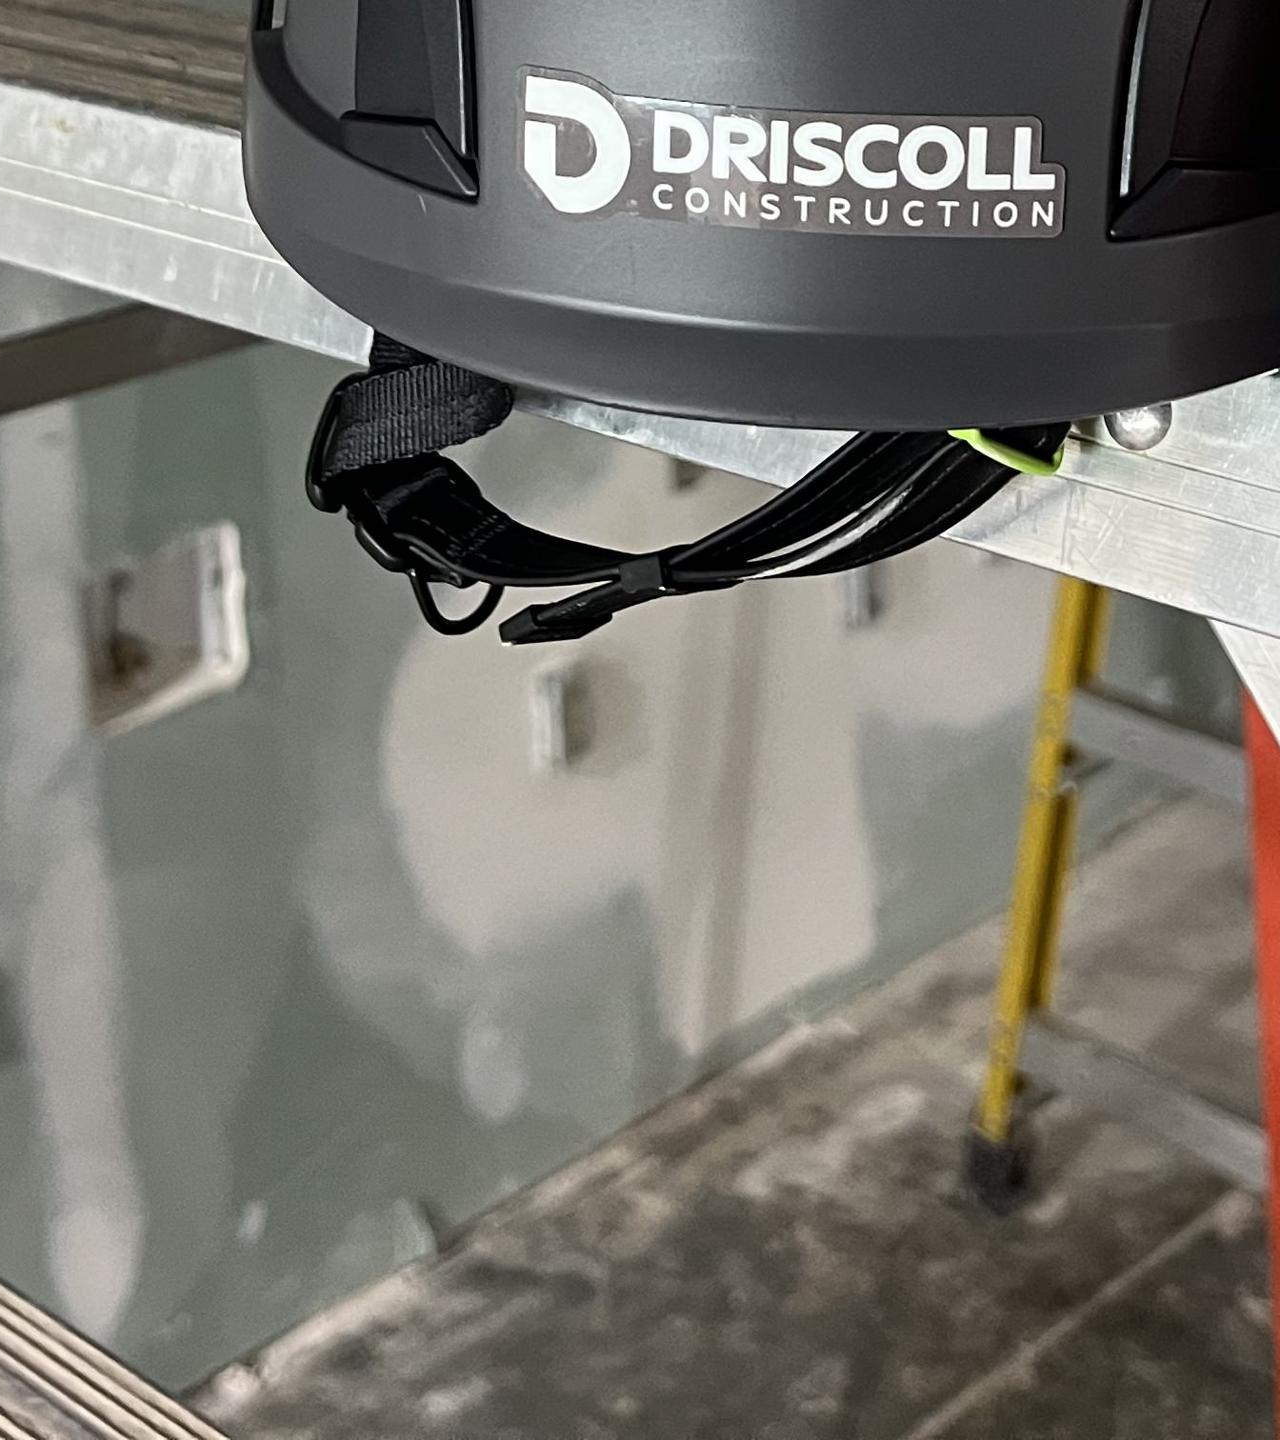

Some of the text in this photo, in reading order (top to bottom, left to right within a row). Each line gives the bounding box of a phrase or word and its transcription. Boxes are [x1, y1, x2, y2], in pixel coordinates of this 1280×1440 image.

[524, 75, 631, 214] D
[652, 109, 1056, 191] DRISCOLL
[651, 183, 1055, 228] CONSTRUCTION
